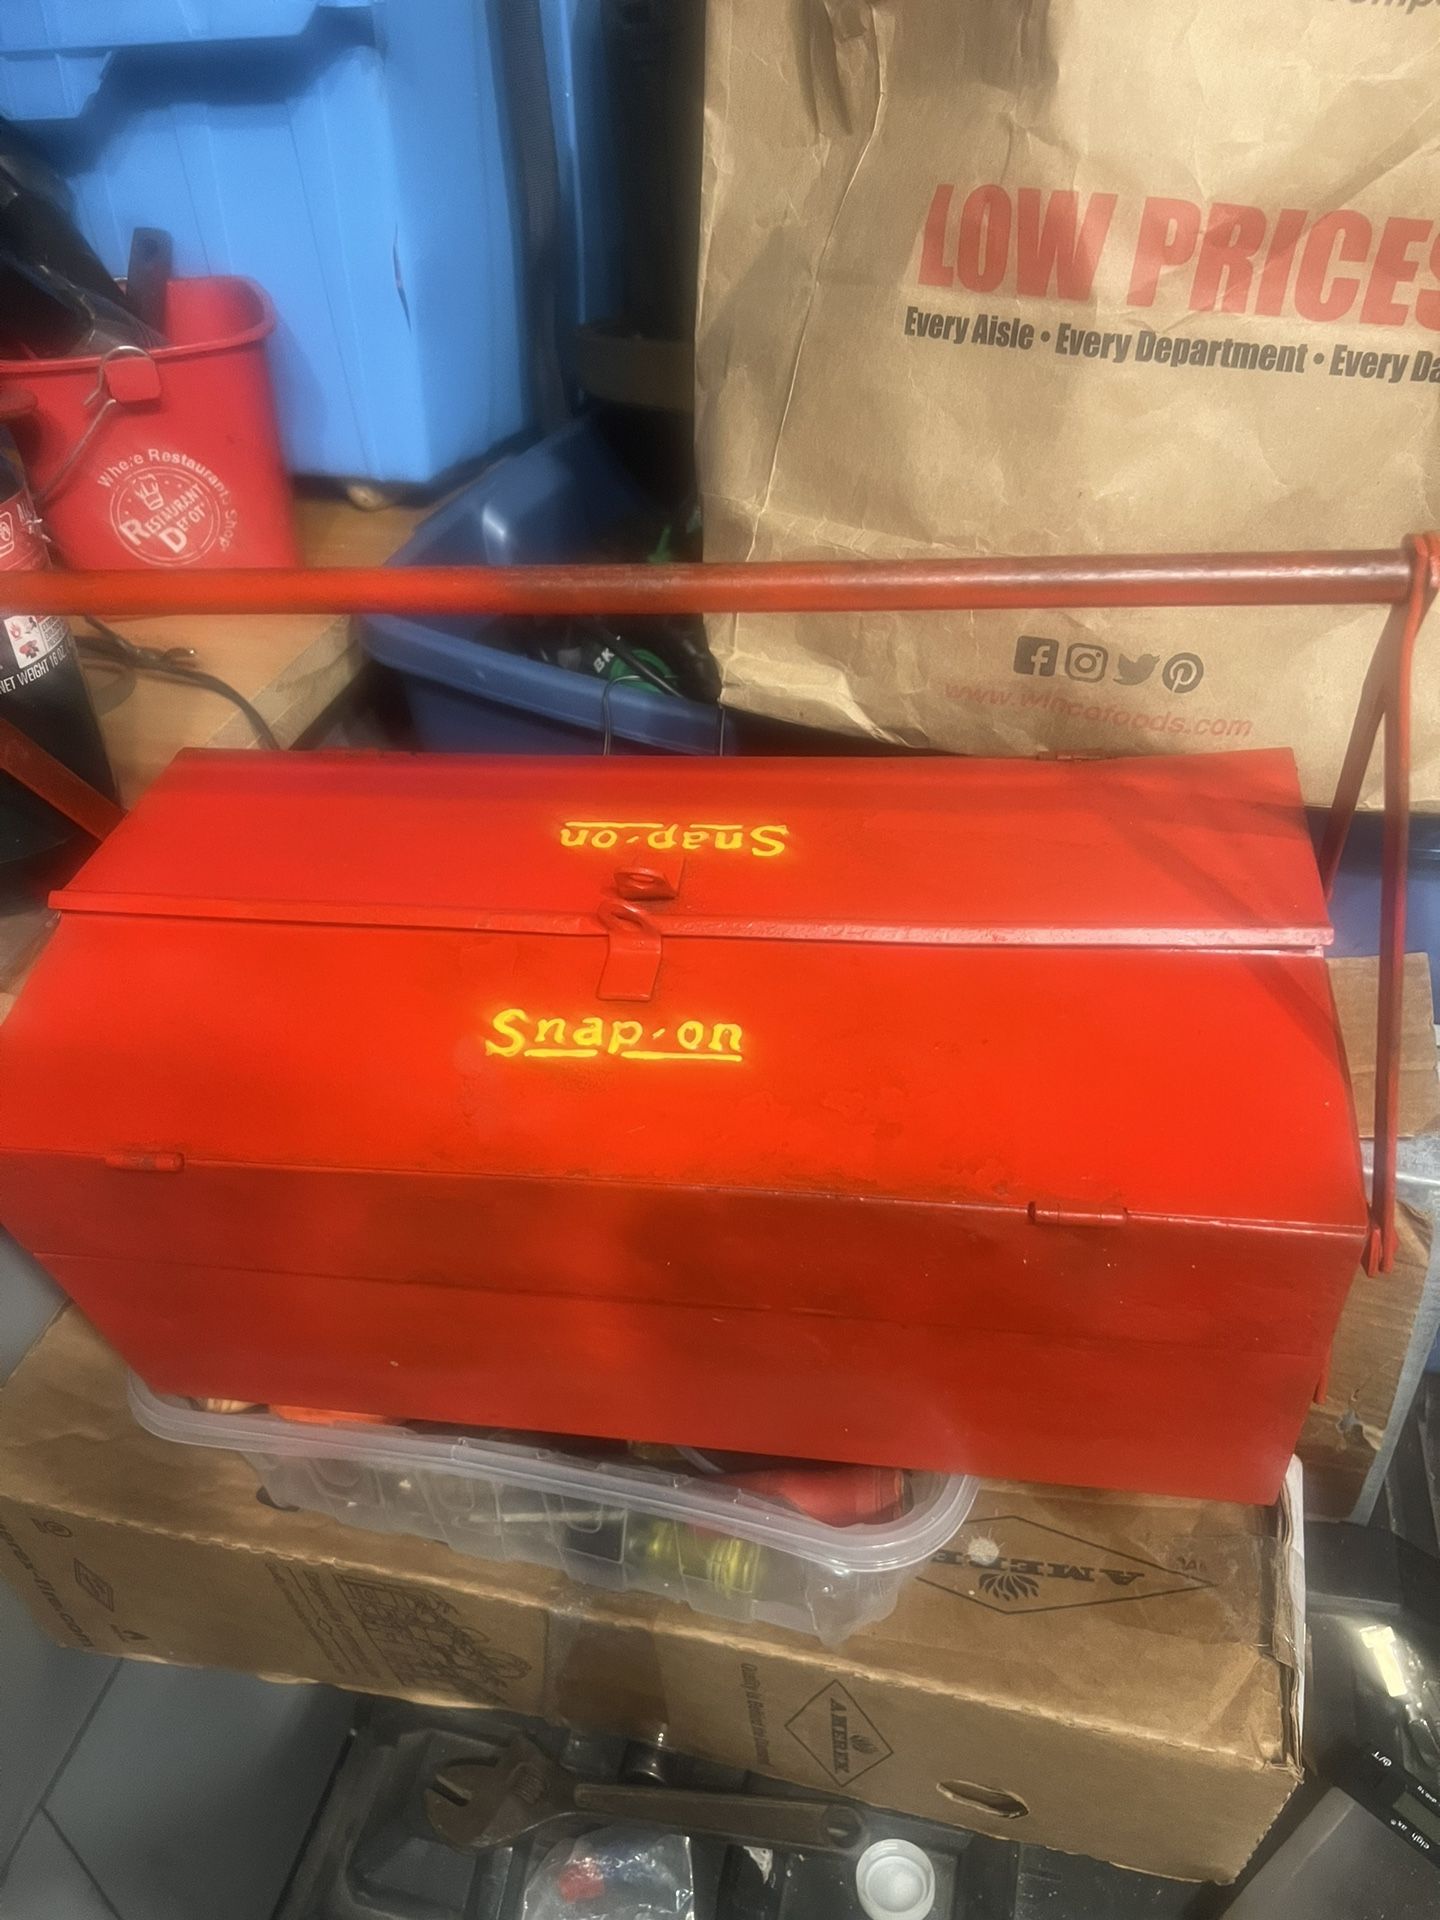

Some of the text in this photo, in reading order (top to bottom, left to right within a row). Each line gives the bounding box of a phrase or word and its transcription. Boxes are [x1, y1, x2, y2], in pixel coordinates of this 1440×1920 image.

[917, 183, 1119, 301] LOW
[904, 306, 970, 344] Every
[971, 314, 1035, 350] Aisle
[1055, 323, 1132, 363] Every
[1134, 330, 1308, 373] Department
[1329, 344, 1410, 383] Every
[120, 483, 204, 545] RESTAURANT
[0, 675, 16, 695] NET
[16, 659, 50, 686] WEIGHT
[49, 651, 59, 668] 16
[593, 647, 615, 673] BK
[560, 822, 789, 857] Snap-on
[485, 1008, 743, 1059] Snap-on
